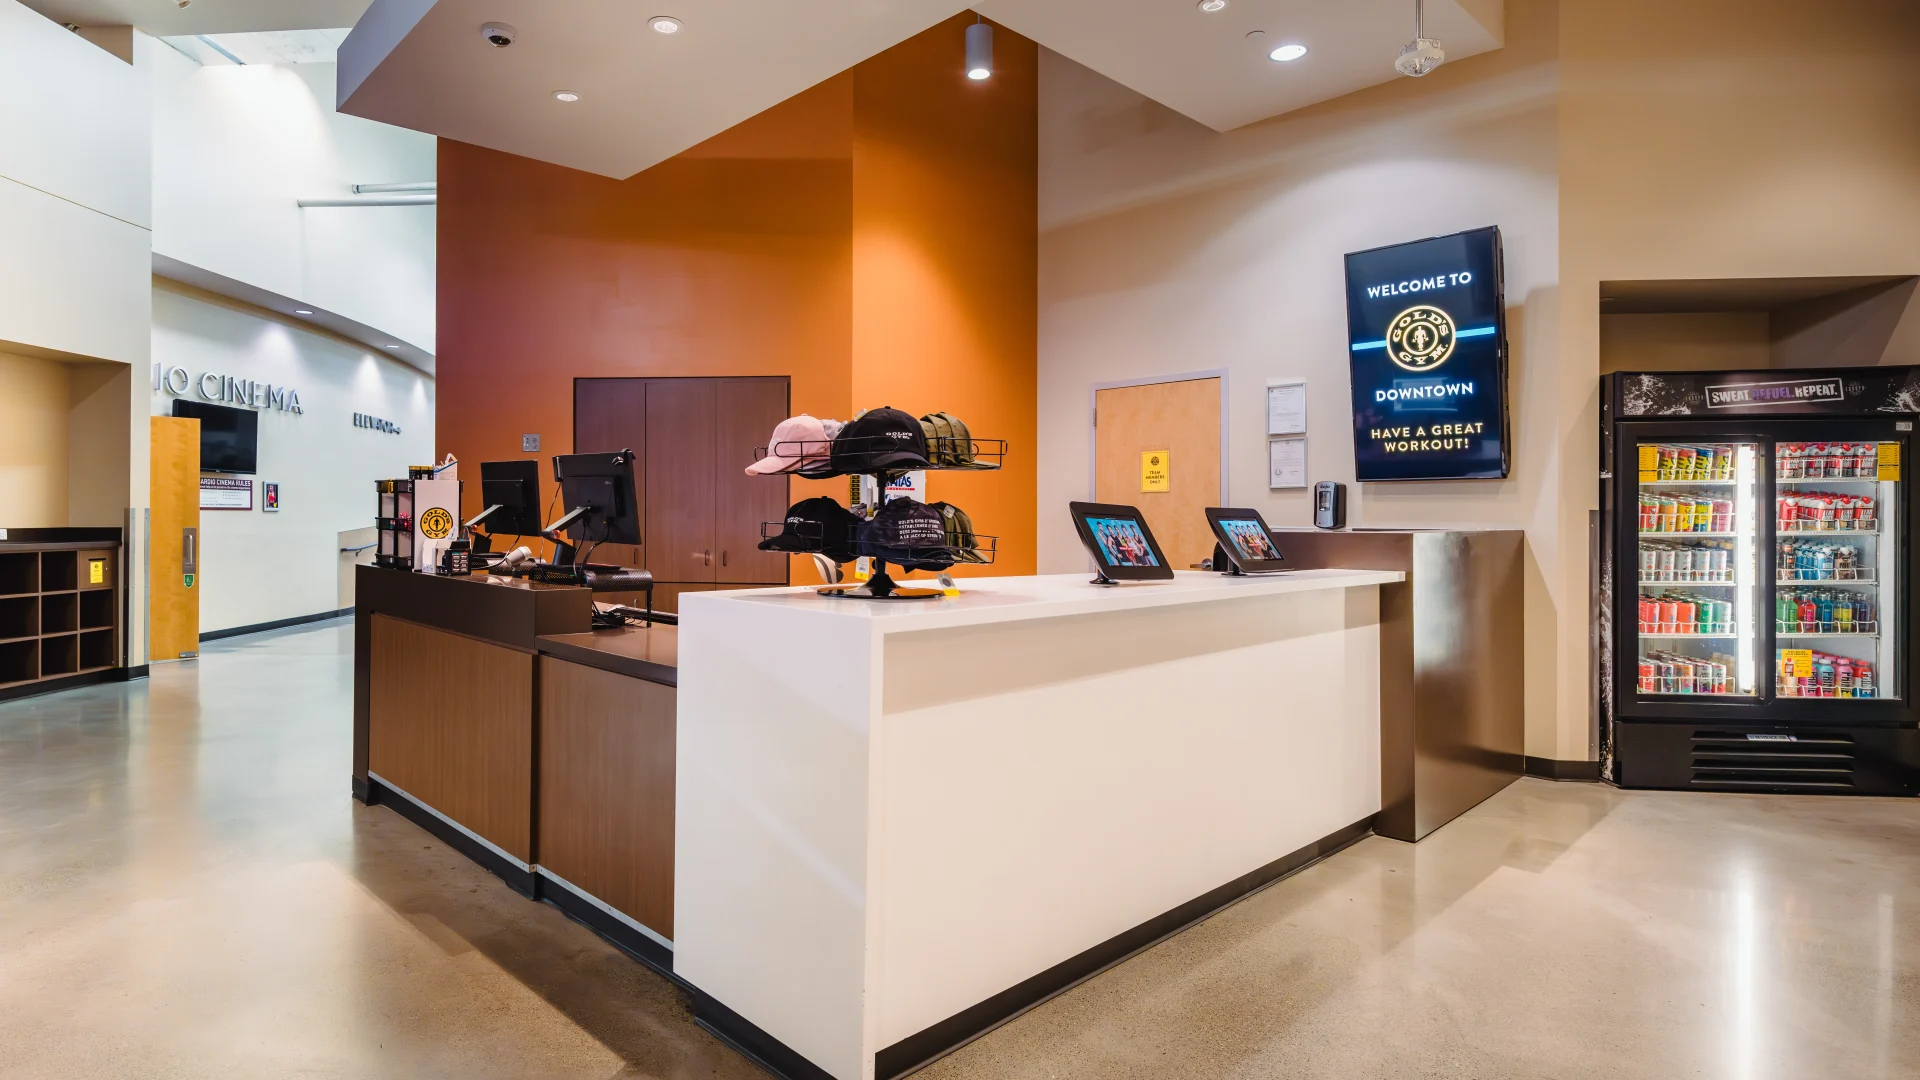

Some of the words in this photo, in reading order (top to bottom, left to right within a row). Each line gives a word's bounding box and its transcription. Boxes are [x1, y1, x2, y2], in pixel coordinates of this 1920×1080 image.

[1367, 275, 1446, 299] WELCOME
[1449, 271, 1472, 286] TO
[1392, 311, 1449, 342] GOLD'S
[198, 371, 303, 415] CINEMA
[1376, 382, 1473, 402] DOWNTOWN
[1712, 389, 1751, 403] SWEAT.
[1795, 383, 1838, 398] REPEAT.
[1371, 427, 1411, 439] HAVE
[1416, 426, 1425, 437] A
[1431, 422, 1483, 436] GREAT
[1384, 438, 1469, 453] WORKOUT!
[200, 478, 216, 486] ARDIO
[216, 478, 235, 487] CINEMA
[236, 479, 251, 487] RULES
[423, 510, 451, 524] GOLD'S
